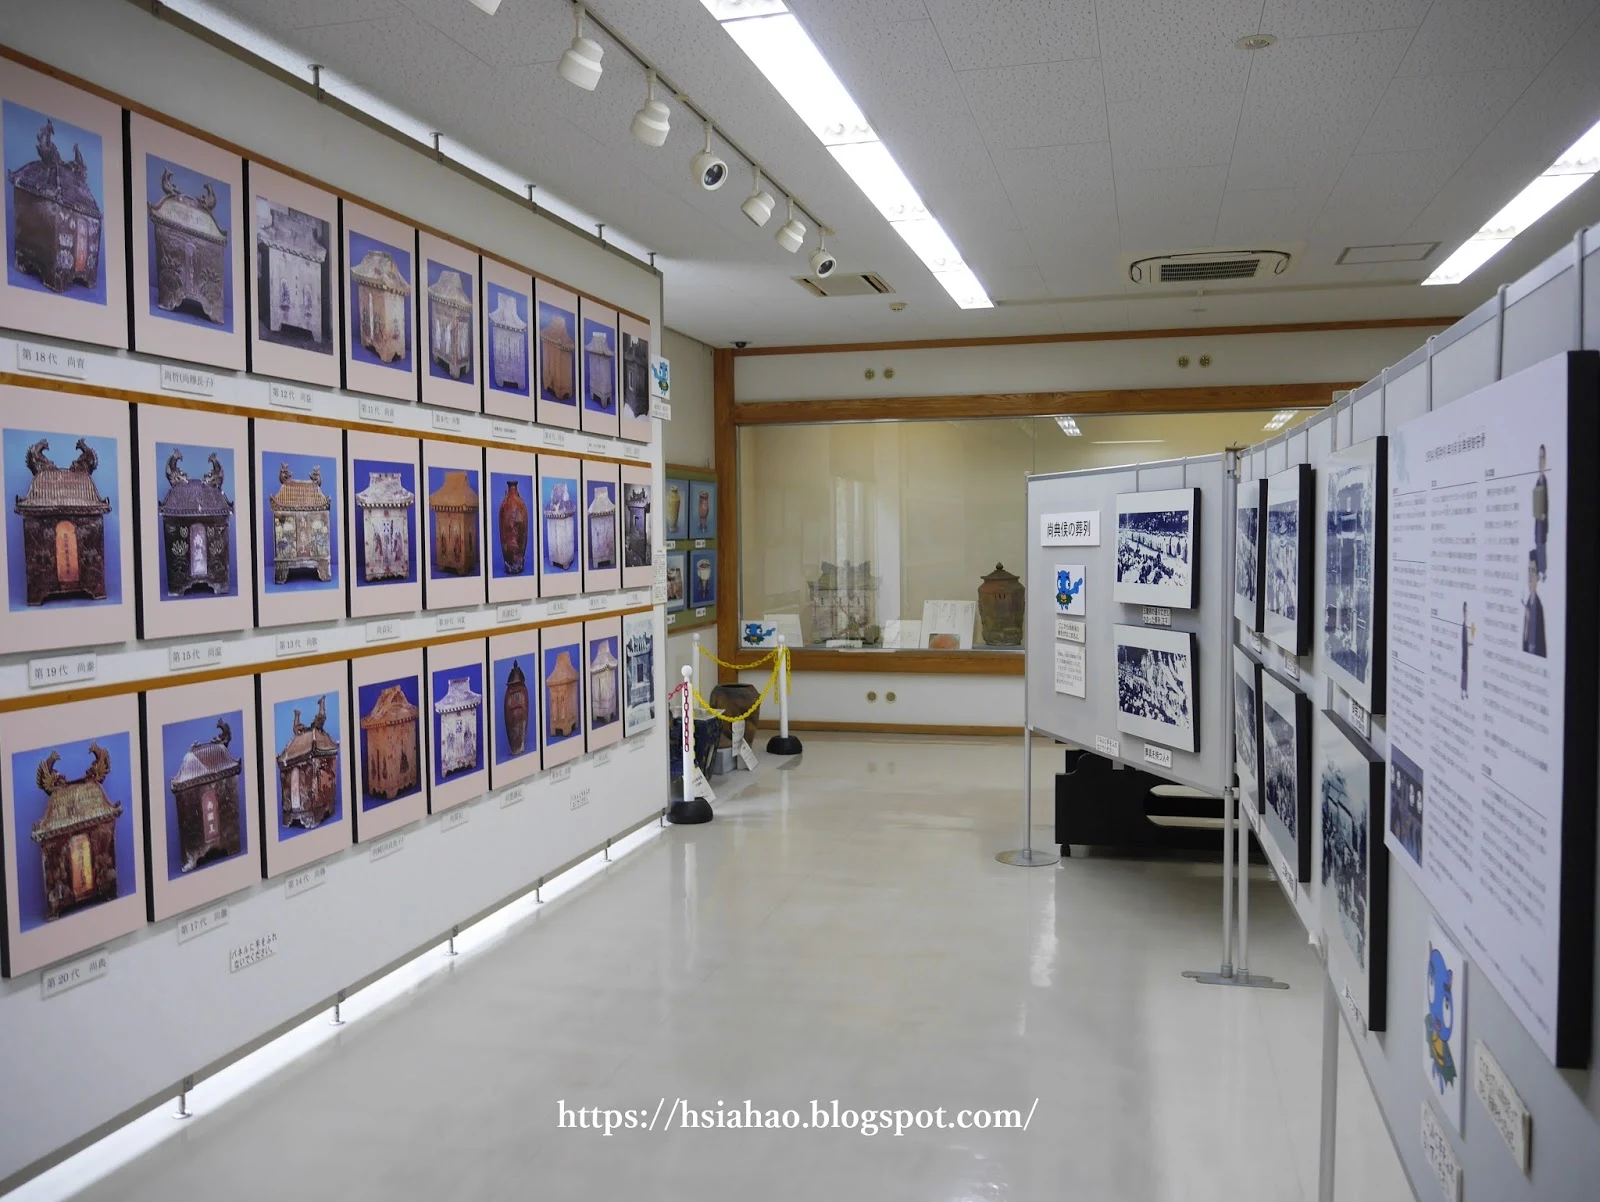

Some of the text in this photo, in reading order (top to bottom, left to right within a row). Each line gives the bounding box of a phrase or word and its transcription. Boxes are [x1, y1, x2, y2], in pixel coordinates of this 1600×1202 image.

[22, 347, 58, 365] 第18代
[272, 387, 295, 400] 第12代
[1047, 520, 1091, 538] 尚典侯の葬列
[279, 639, 301, 650] 第13代
[172, 649, 200, 663] 第15代
[34, 660, 95, 680] 第19代 尚泰
[181, 915, 208, 935] 第17代
[47, 967, 81, 989] 第20代
